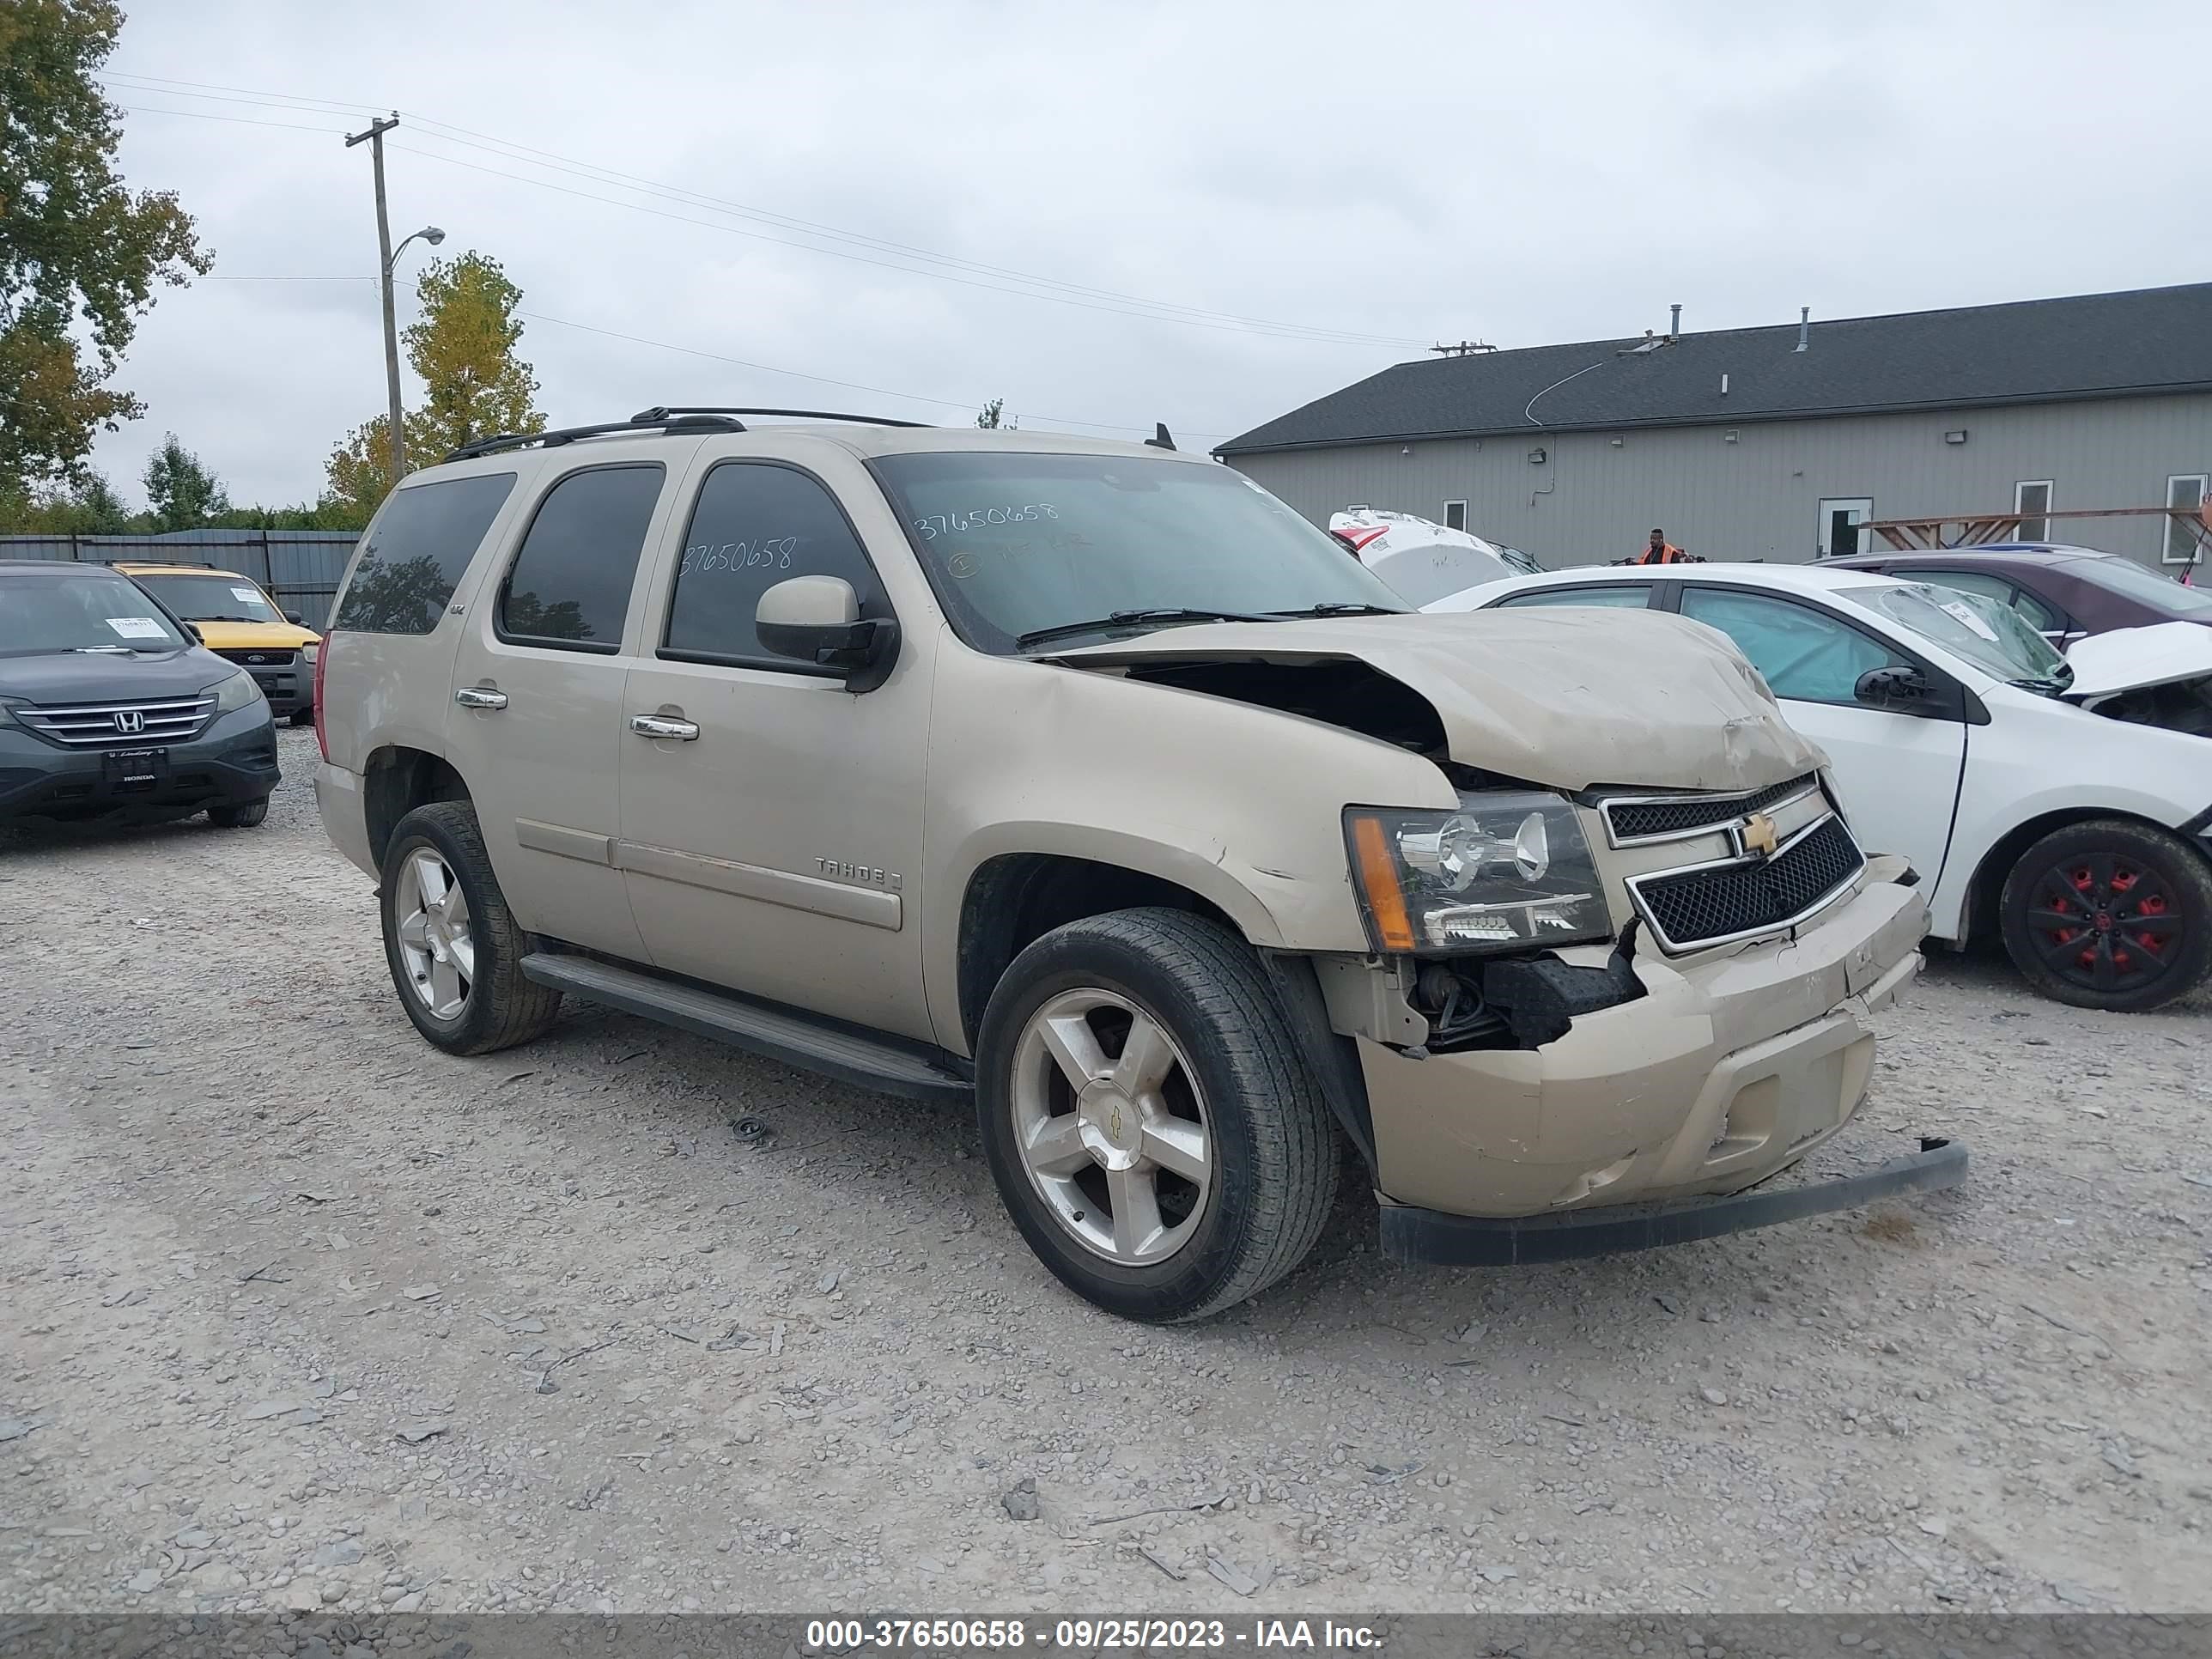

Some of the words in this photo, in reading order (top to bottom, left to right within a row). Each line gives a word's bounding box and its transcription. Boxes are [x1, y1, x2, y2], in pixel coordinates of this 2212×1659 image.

[915, 503, 1059, 540] 37650658
[678, 536, 797, 577] 37650658
[815, 857, 884, 884] TAHOE
